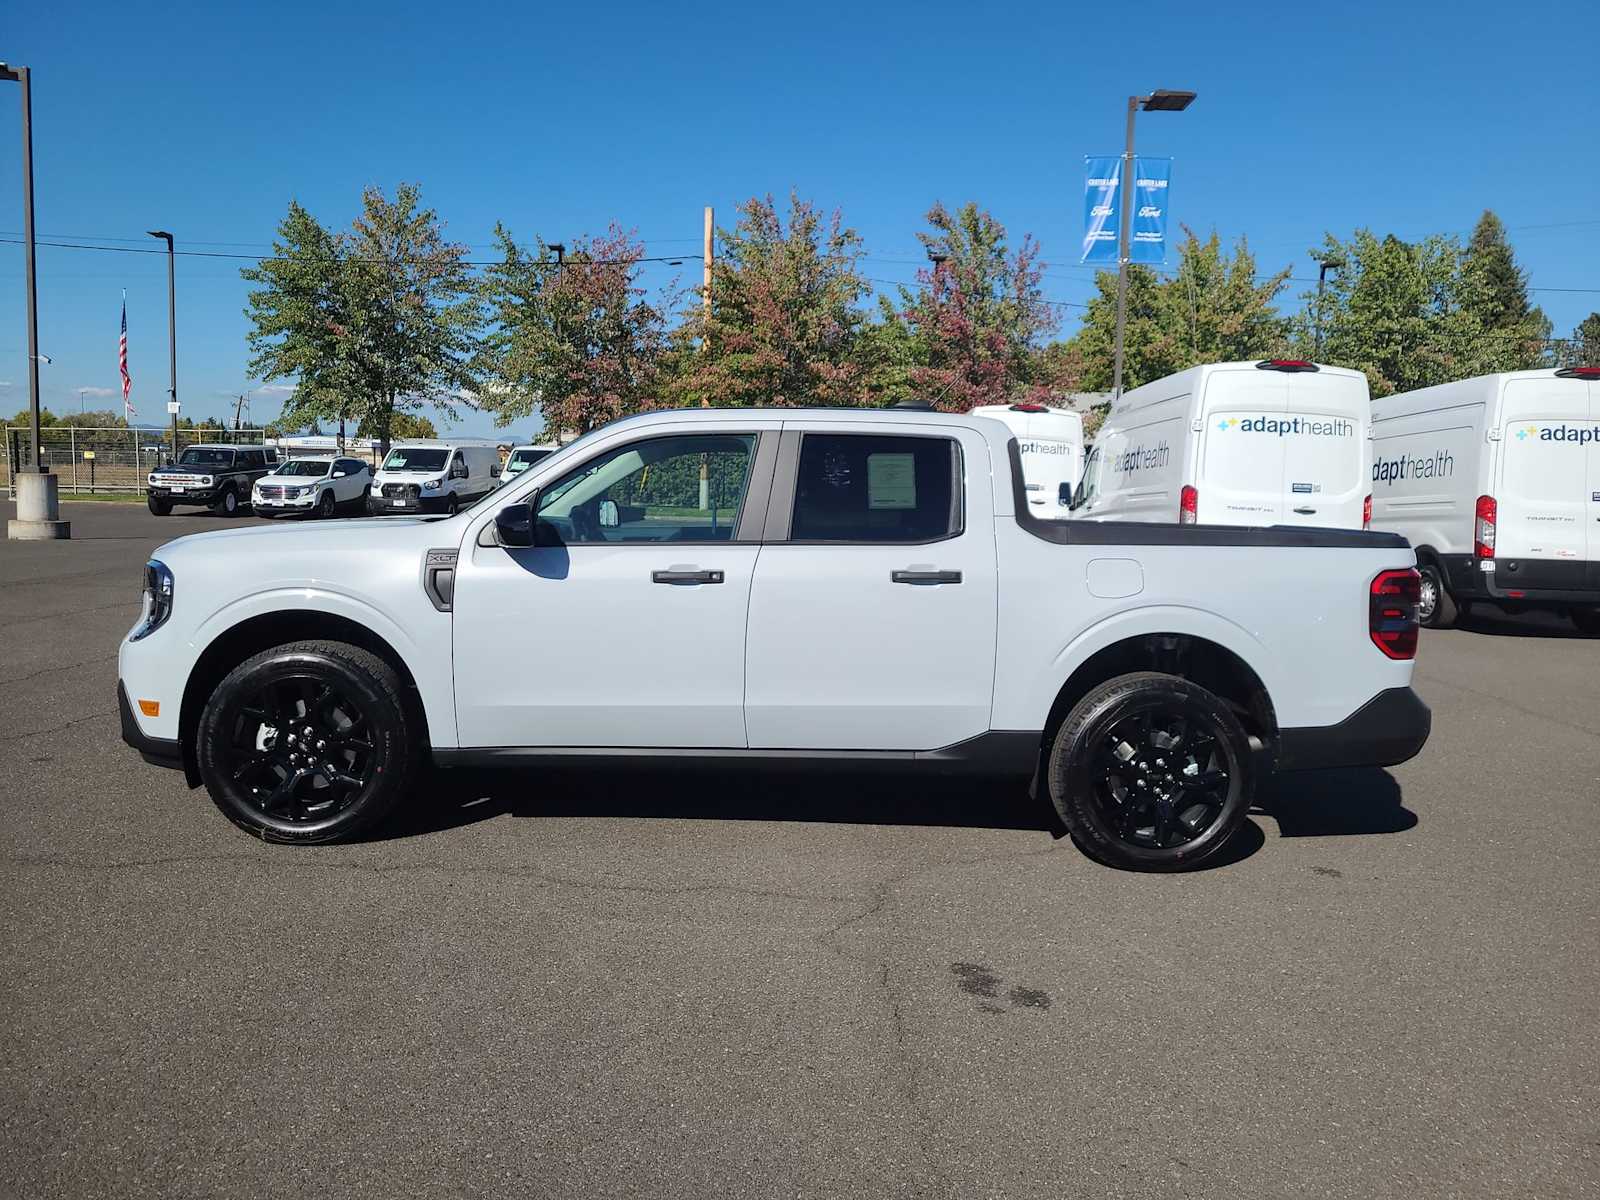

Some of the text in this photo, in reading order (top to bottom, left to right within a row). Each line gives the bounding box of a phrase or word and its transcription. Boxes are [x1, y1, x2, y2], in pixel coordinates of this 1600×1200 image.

[1138, 206, 1162, 217] Ford
[1241, 416, 1353, 437] adapthealth
[1020, 442, 1070, 456] pthealth
[1372, 449, 1454, 486] dapthealth
